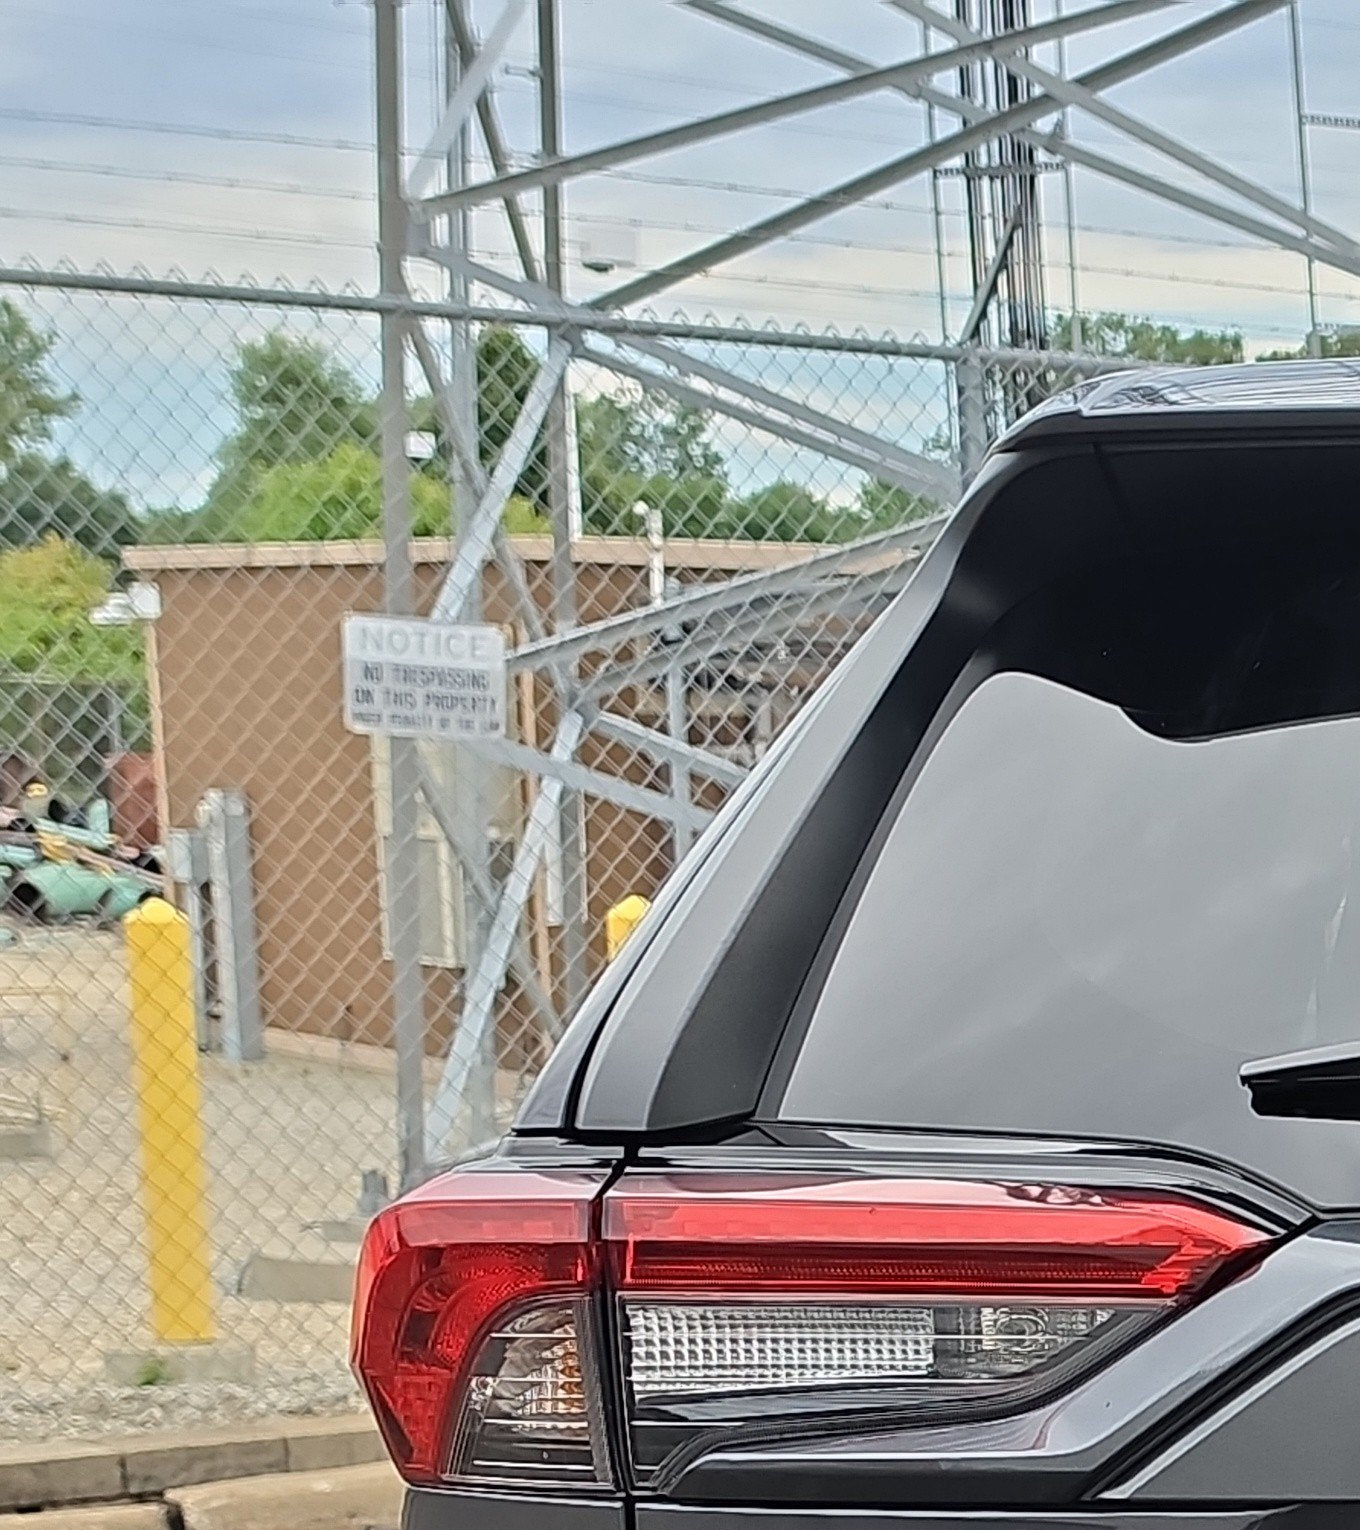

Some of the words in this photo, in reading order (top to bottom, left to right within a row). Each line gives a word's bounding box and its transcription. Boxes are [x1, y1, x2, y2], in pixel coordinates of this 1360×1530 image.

[361, 625, 490, 660] NOTICE
[364, 662, 383, 684] NO
[393, 664, 490, 691] TRESPASSING
[355, 687, 375, 705] ON
[383, 688, 417, 710] THIS
